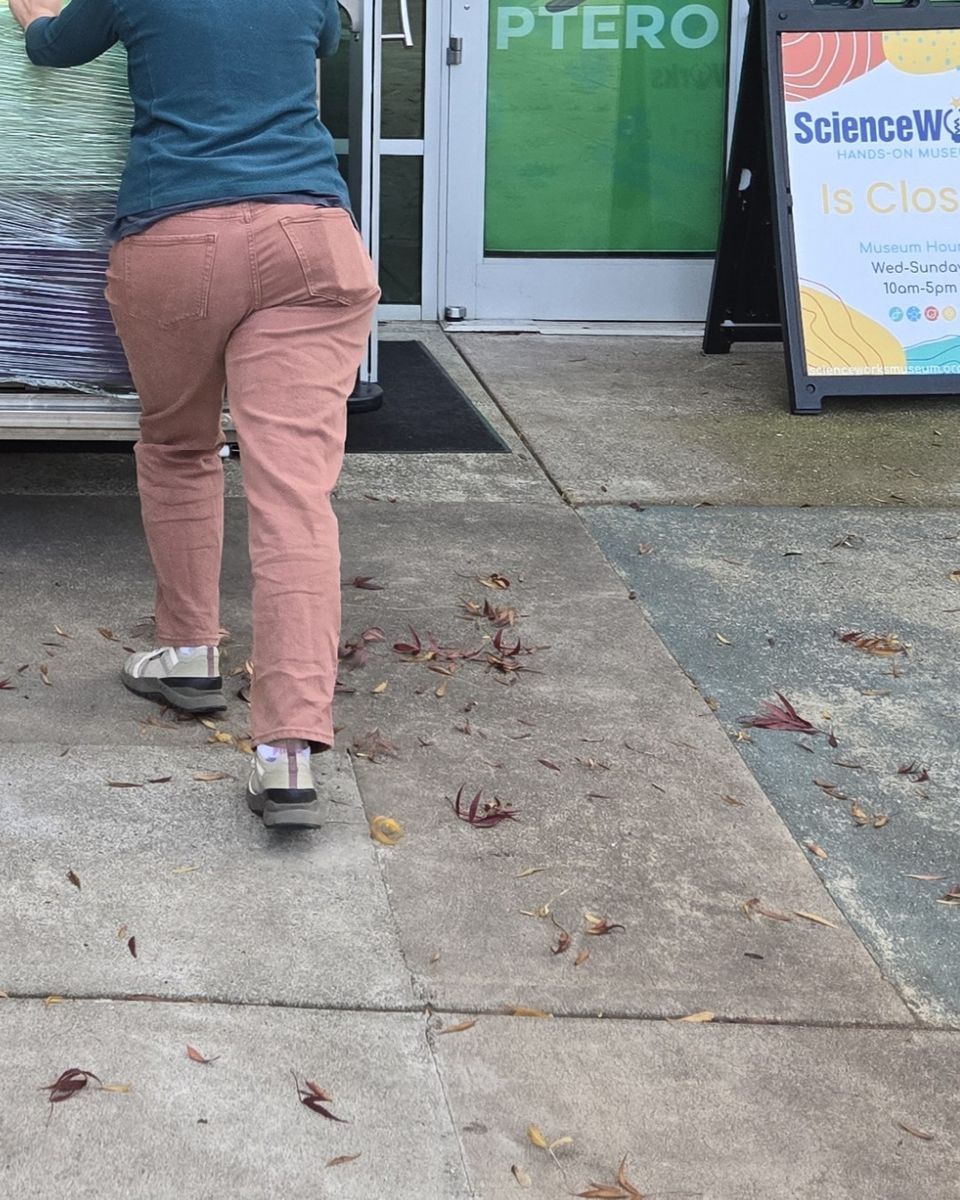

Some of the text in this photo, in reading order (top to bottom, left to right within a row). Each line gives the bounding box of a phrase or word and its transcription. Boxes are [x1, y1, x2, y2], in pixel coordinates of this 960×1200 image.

[496, 4, 719, 49] PTERO
[837, 147, 960, 160] HANDS-ON MUSE
[821, 179, 960, 215] Is Clos
[859, 241, 922, 254] Museum
[883, 280, 958, 297] 10am-5pm
